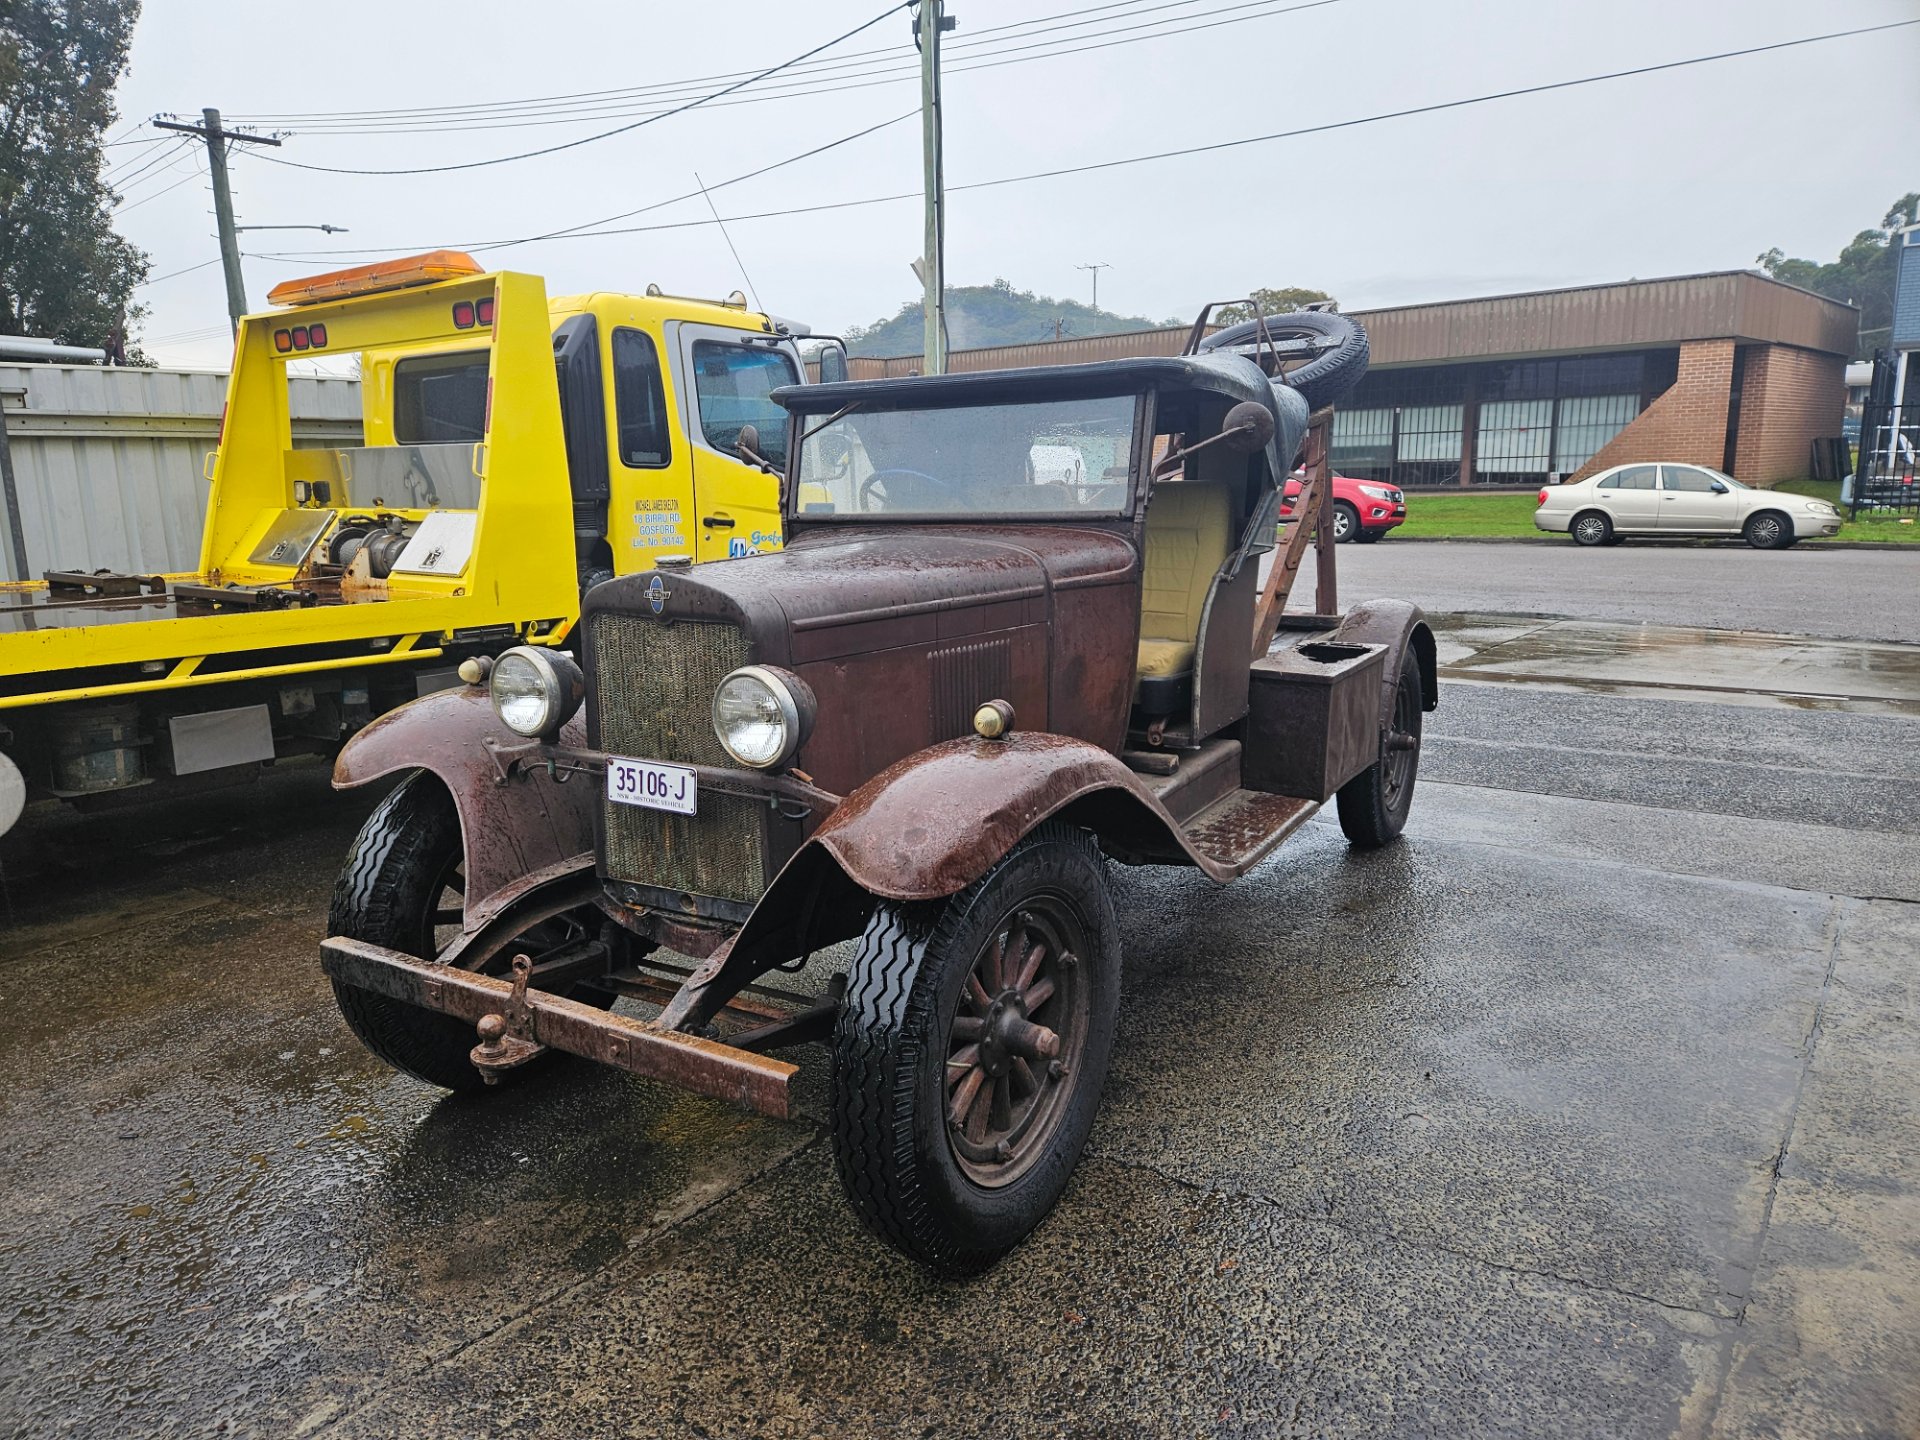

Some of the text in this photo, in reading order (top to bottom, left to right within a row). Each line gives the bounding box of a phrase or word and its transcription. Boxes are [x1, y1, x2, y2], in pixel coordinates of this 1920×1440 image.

[634, 514, 643, 523] 18
[633, 795, 659, 805] HISTORIC
[661, 799, 685, 808] VEHICLE
